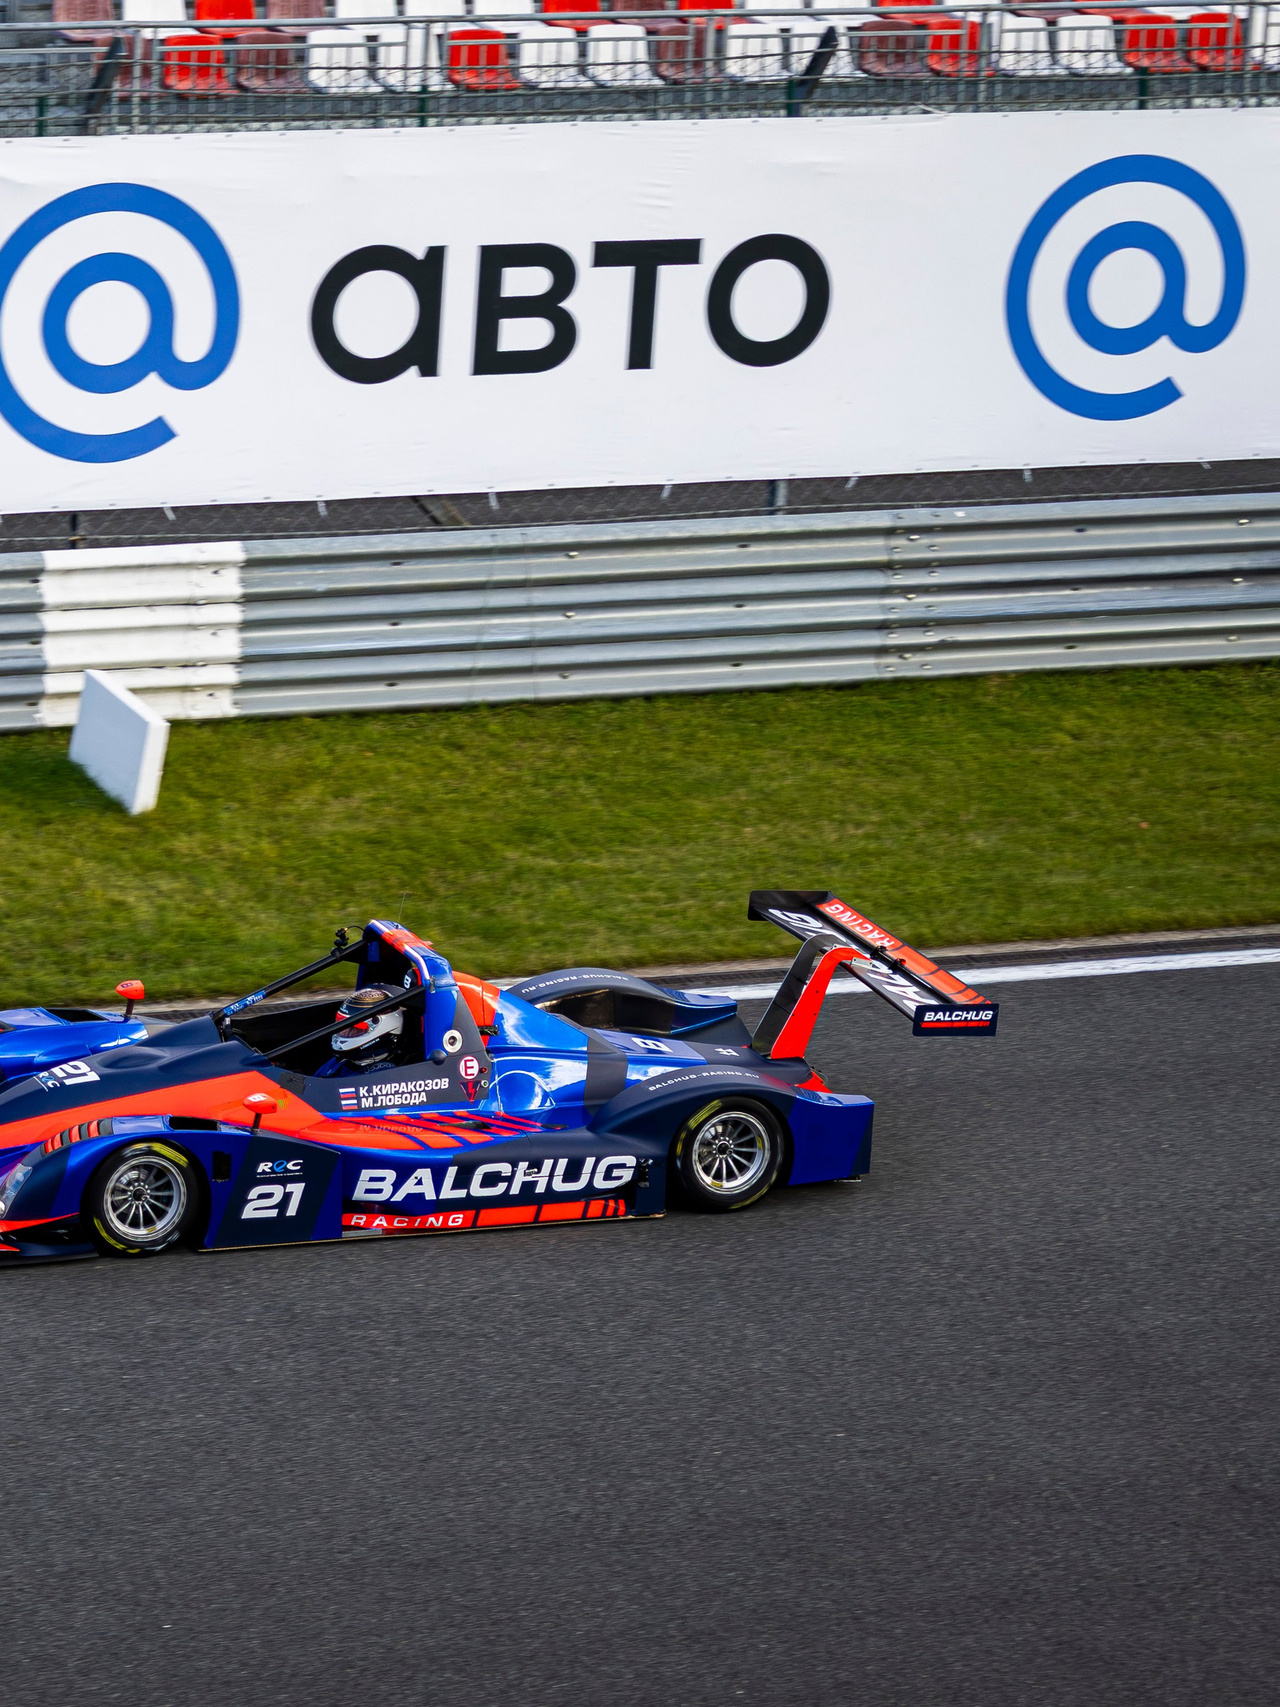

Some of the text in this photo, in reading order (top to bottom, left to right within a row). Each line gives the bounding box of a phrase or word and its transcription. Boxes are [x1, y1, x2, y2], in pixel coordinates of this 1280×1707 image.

[824, 903, 895, 949] RACING
[923, 1010, 994, 1022] BALCHUG
[50, 1060, 101, 1086] 21
[464, 1059, 475, 1076] E
[359, 1078, 450, 1098] К.КИРАКОЗОВ
[361, 1092, 428, 1108] М.ЛОБОДА
[352, 1155, 638, 1202] BALCHUG
[241, 1182, 306, 1219] 21
[351, 1213, 464, 1227] RACING
